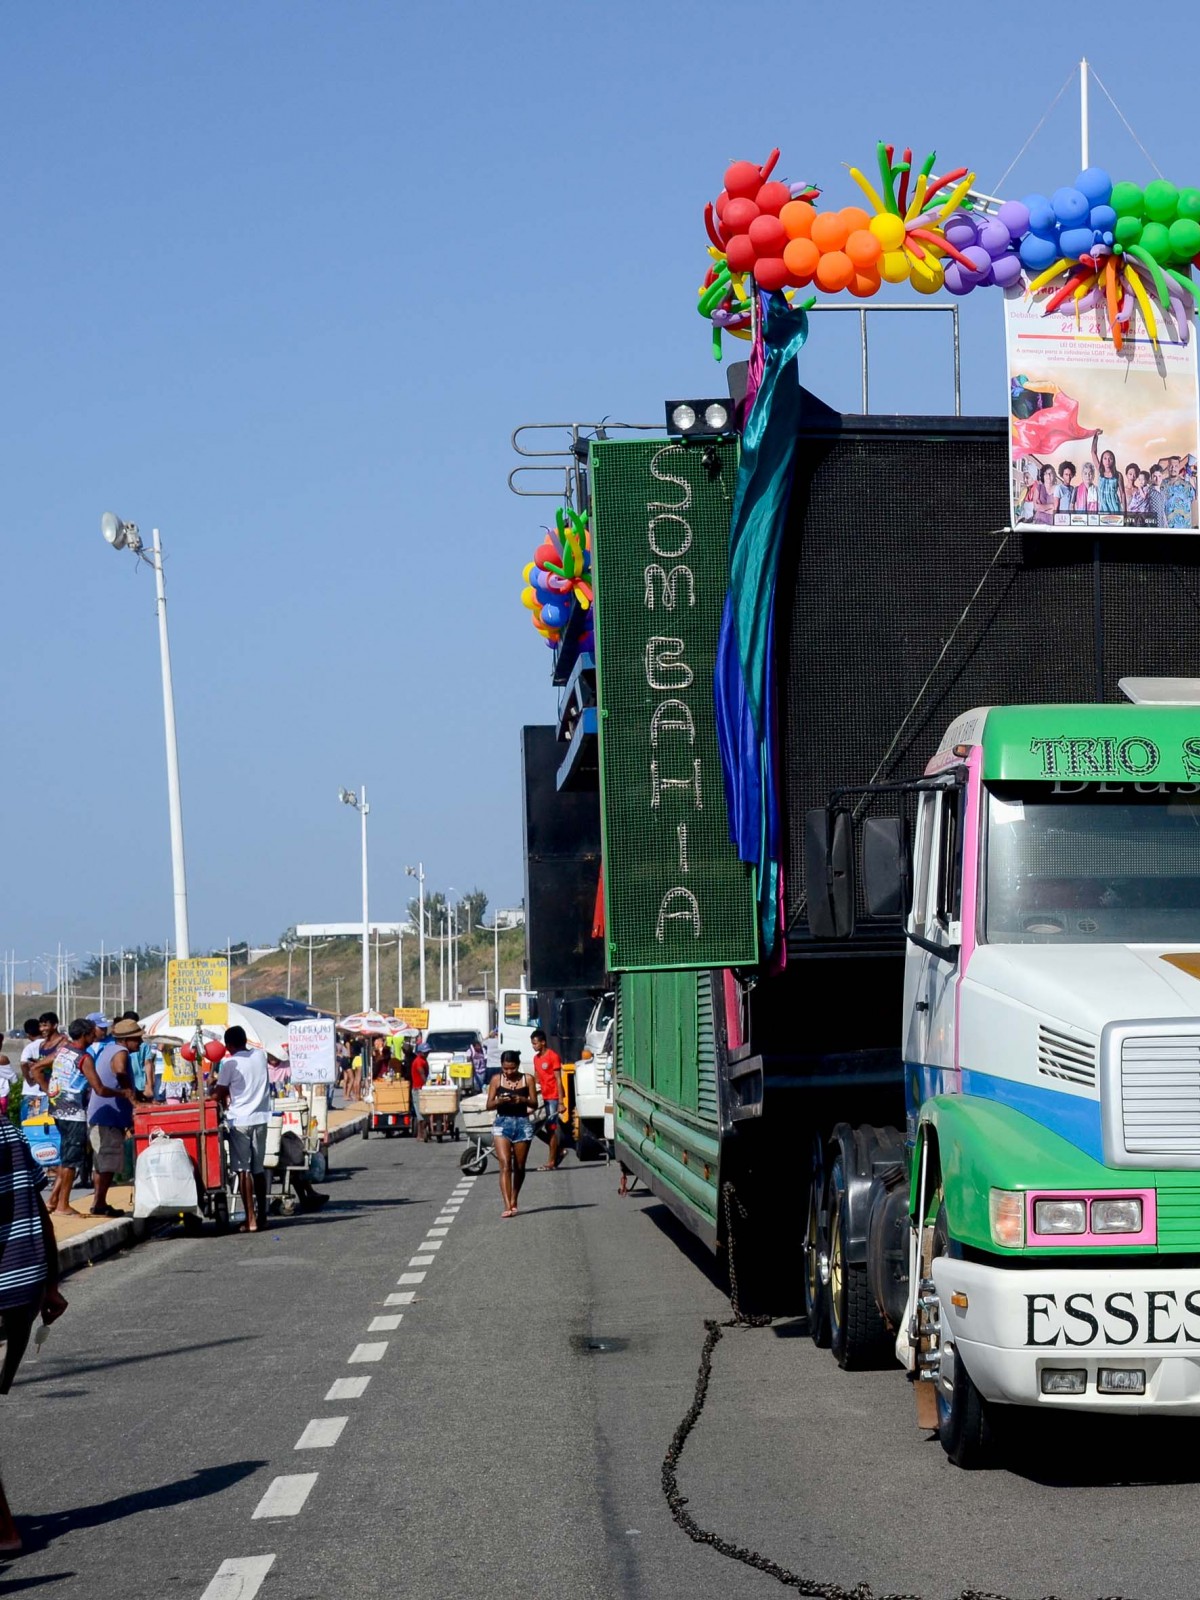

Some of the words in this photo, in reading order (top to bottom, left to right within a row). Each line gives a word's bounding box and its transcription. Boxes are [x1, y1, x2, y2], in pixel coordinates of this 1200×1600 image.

[646, 444, 696, 611] SOM
[1029, 734, 1161, 778] TRIO
[646, 634, 702, 944] BAHIA
[173, 995, 197, 1003] SKOL
[173, 1003, 191, 1011] RED
[194, 1002, 212, 1010] BULL
[173, 1010, 198, 1019] VINHO
